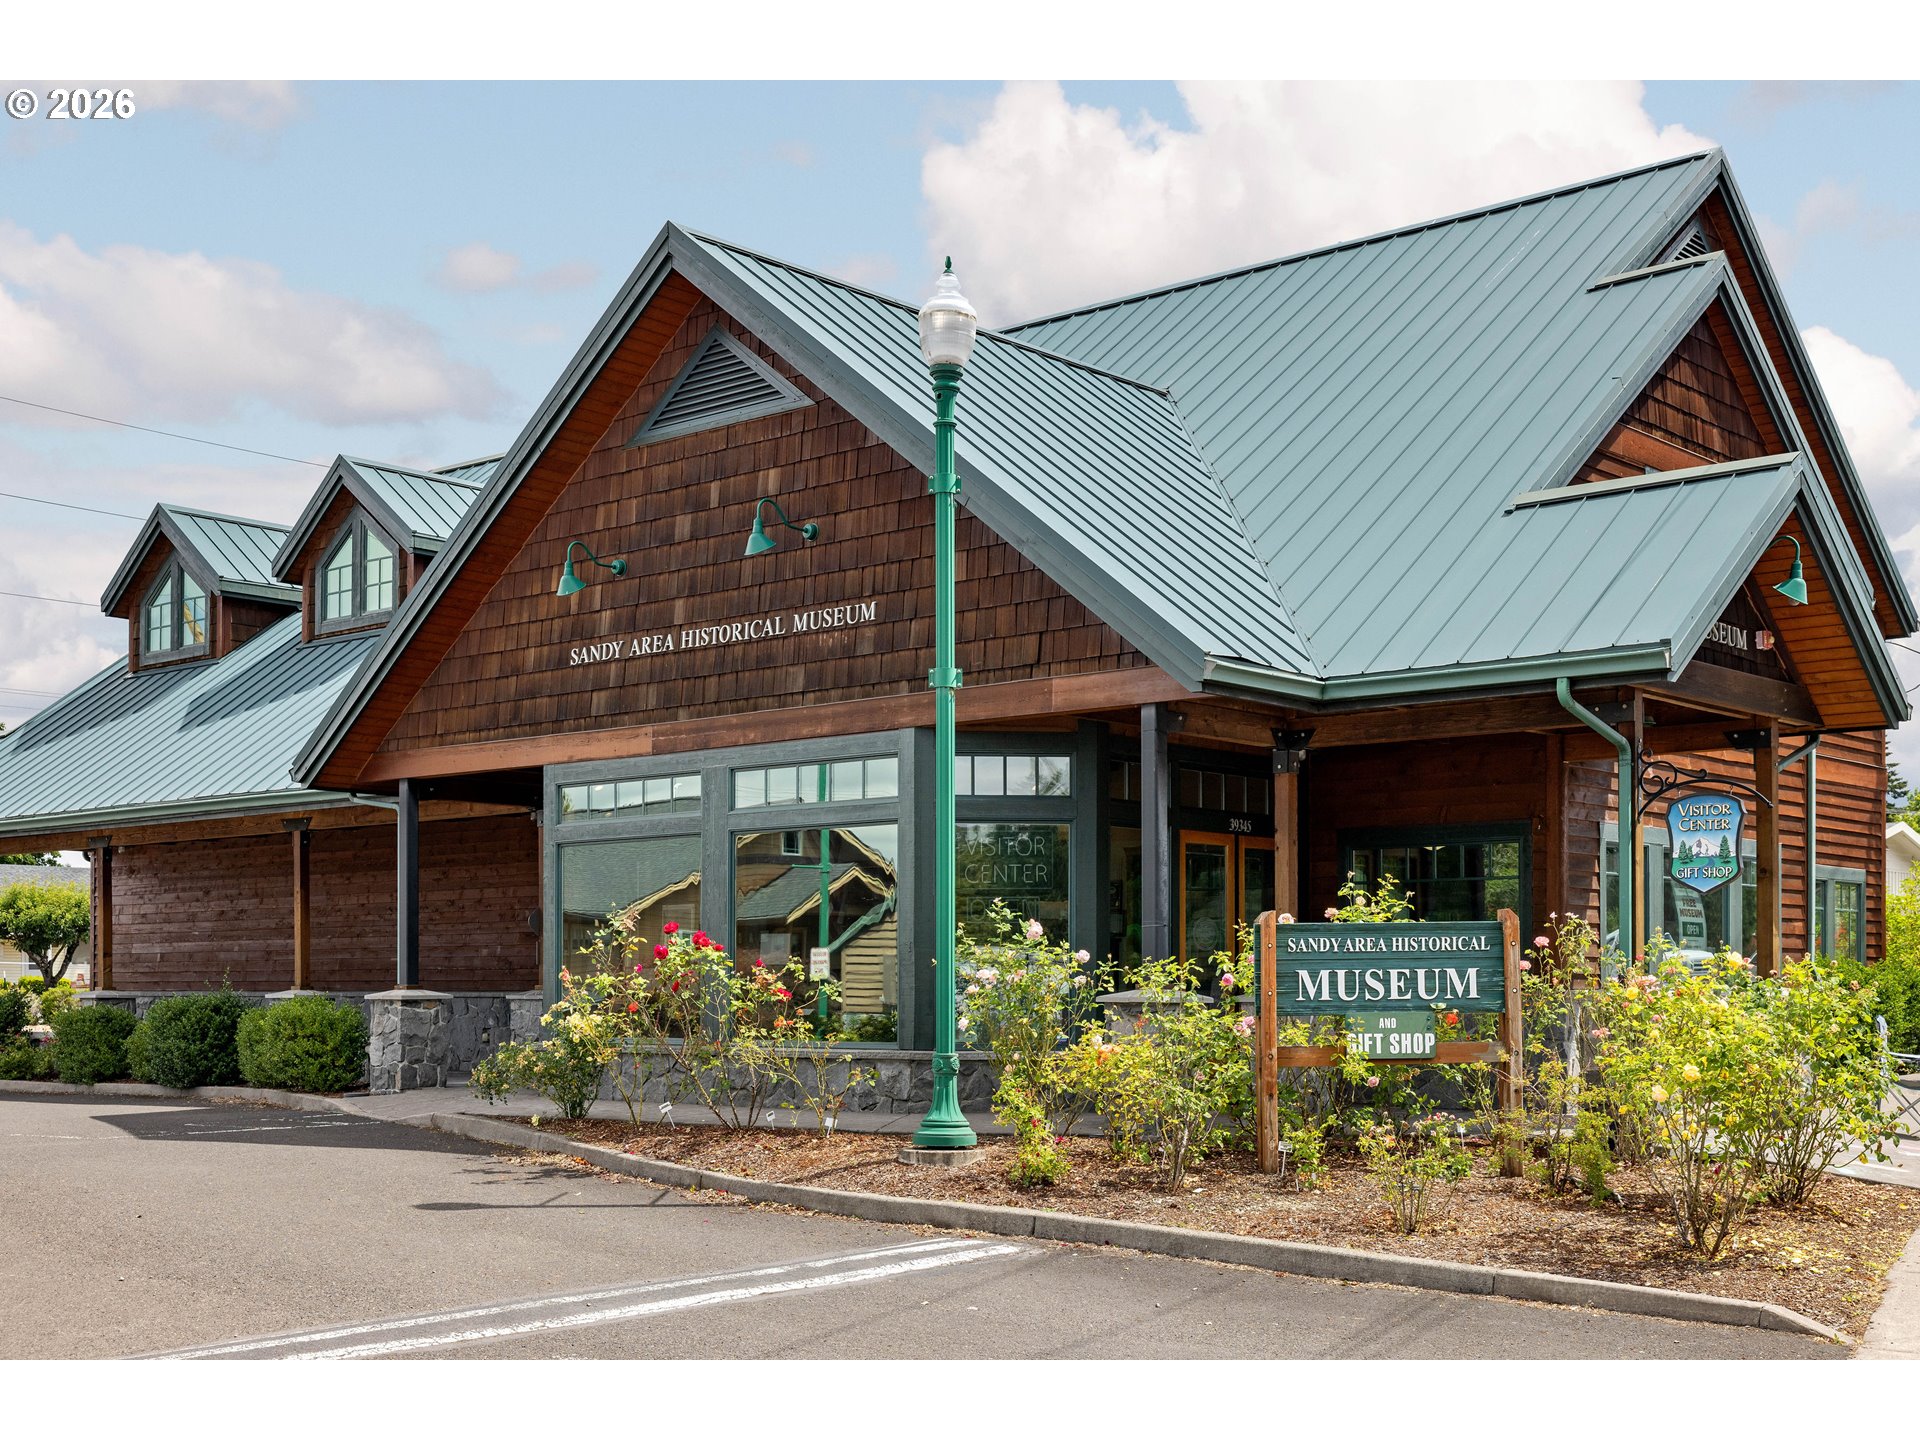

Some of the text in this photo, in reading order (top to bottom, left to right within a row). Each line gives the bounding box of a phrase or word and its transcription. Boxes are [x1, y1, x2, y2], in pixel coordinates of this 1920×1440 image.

[570, 601, 877, 666] SANDY AREA HISTORICAL MUSEUM
[1678, 803, 1732, 817] VISITOR
[1228, 818, 1252, 833] 39345
[1678, 818, 1731, 832] CENTER
[965, 836, 1046, 856] VISITOR
[964, 864, 1048, 884] CENTER
[1676, 866, 1733, 879] GIFT SHOP
[1681, 897, 1697, 908] FREE
[1679, 907, 1703, 919] MUSEUM
[1686, 924, 1700, 935] OPEN
[1287, 936, 1490, 953] SANDY AREA HISTORICAL
[1295, 967, 1481, 1001] MUSEUM
[1379, 1017, 1397, 1029] AND
[1389, 1032, 1435, 1054] SHOP
